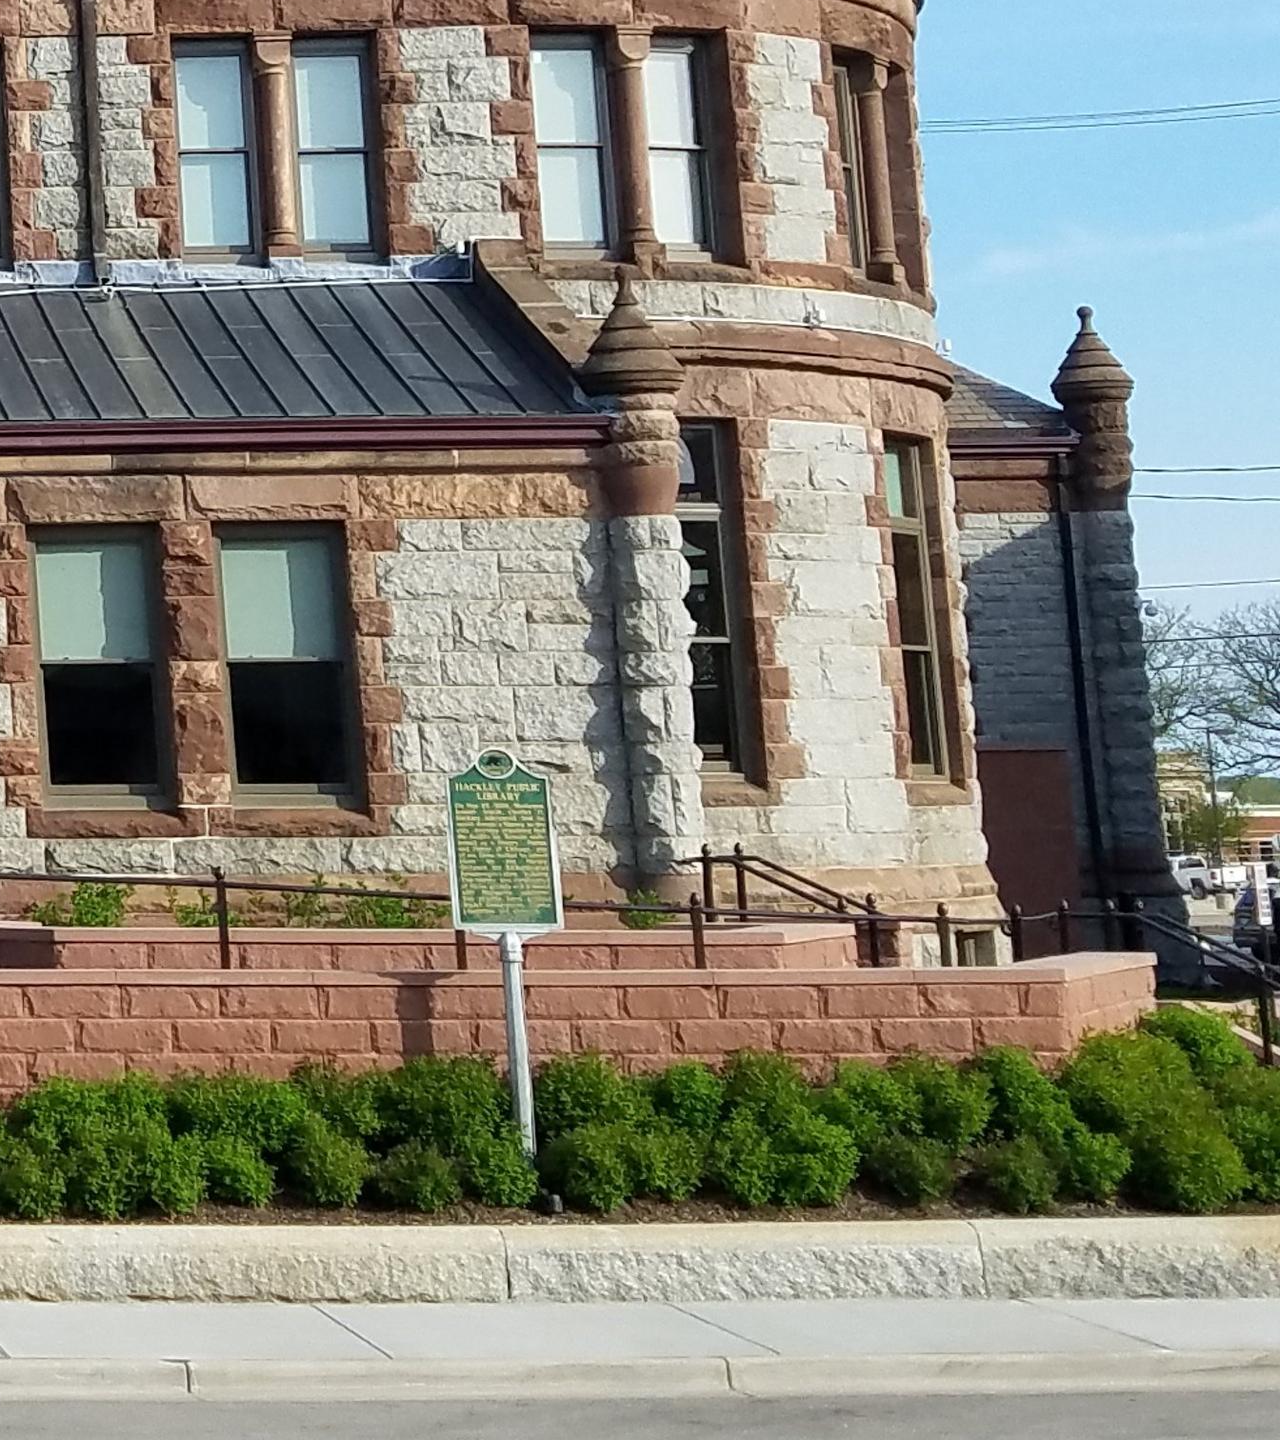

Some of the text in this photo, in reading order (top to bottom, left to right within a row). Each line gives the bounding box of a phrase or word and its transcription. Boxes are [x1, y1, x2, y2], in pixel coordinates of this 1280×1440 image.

[455, 782, 540, 792] HACKLEY PUBLIC
[476, 792, 520, 800] LIBRARY
